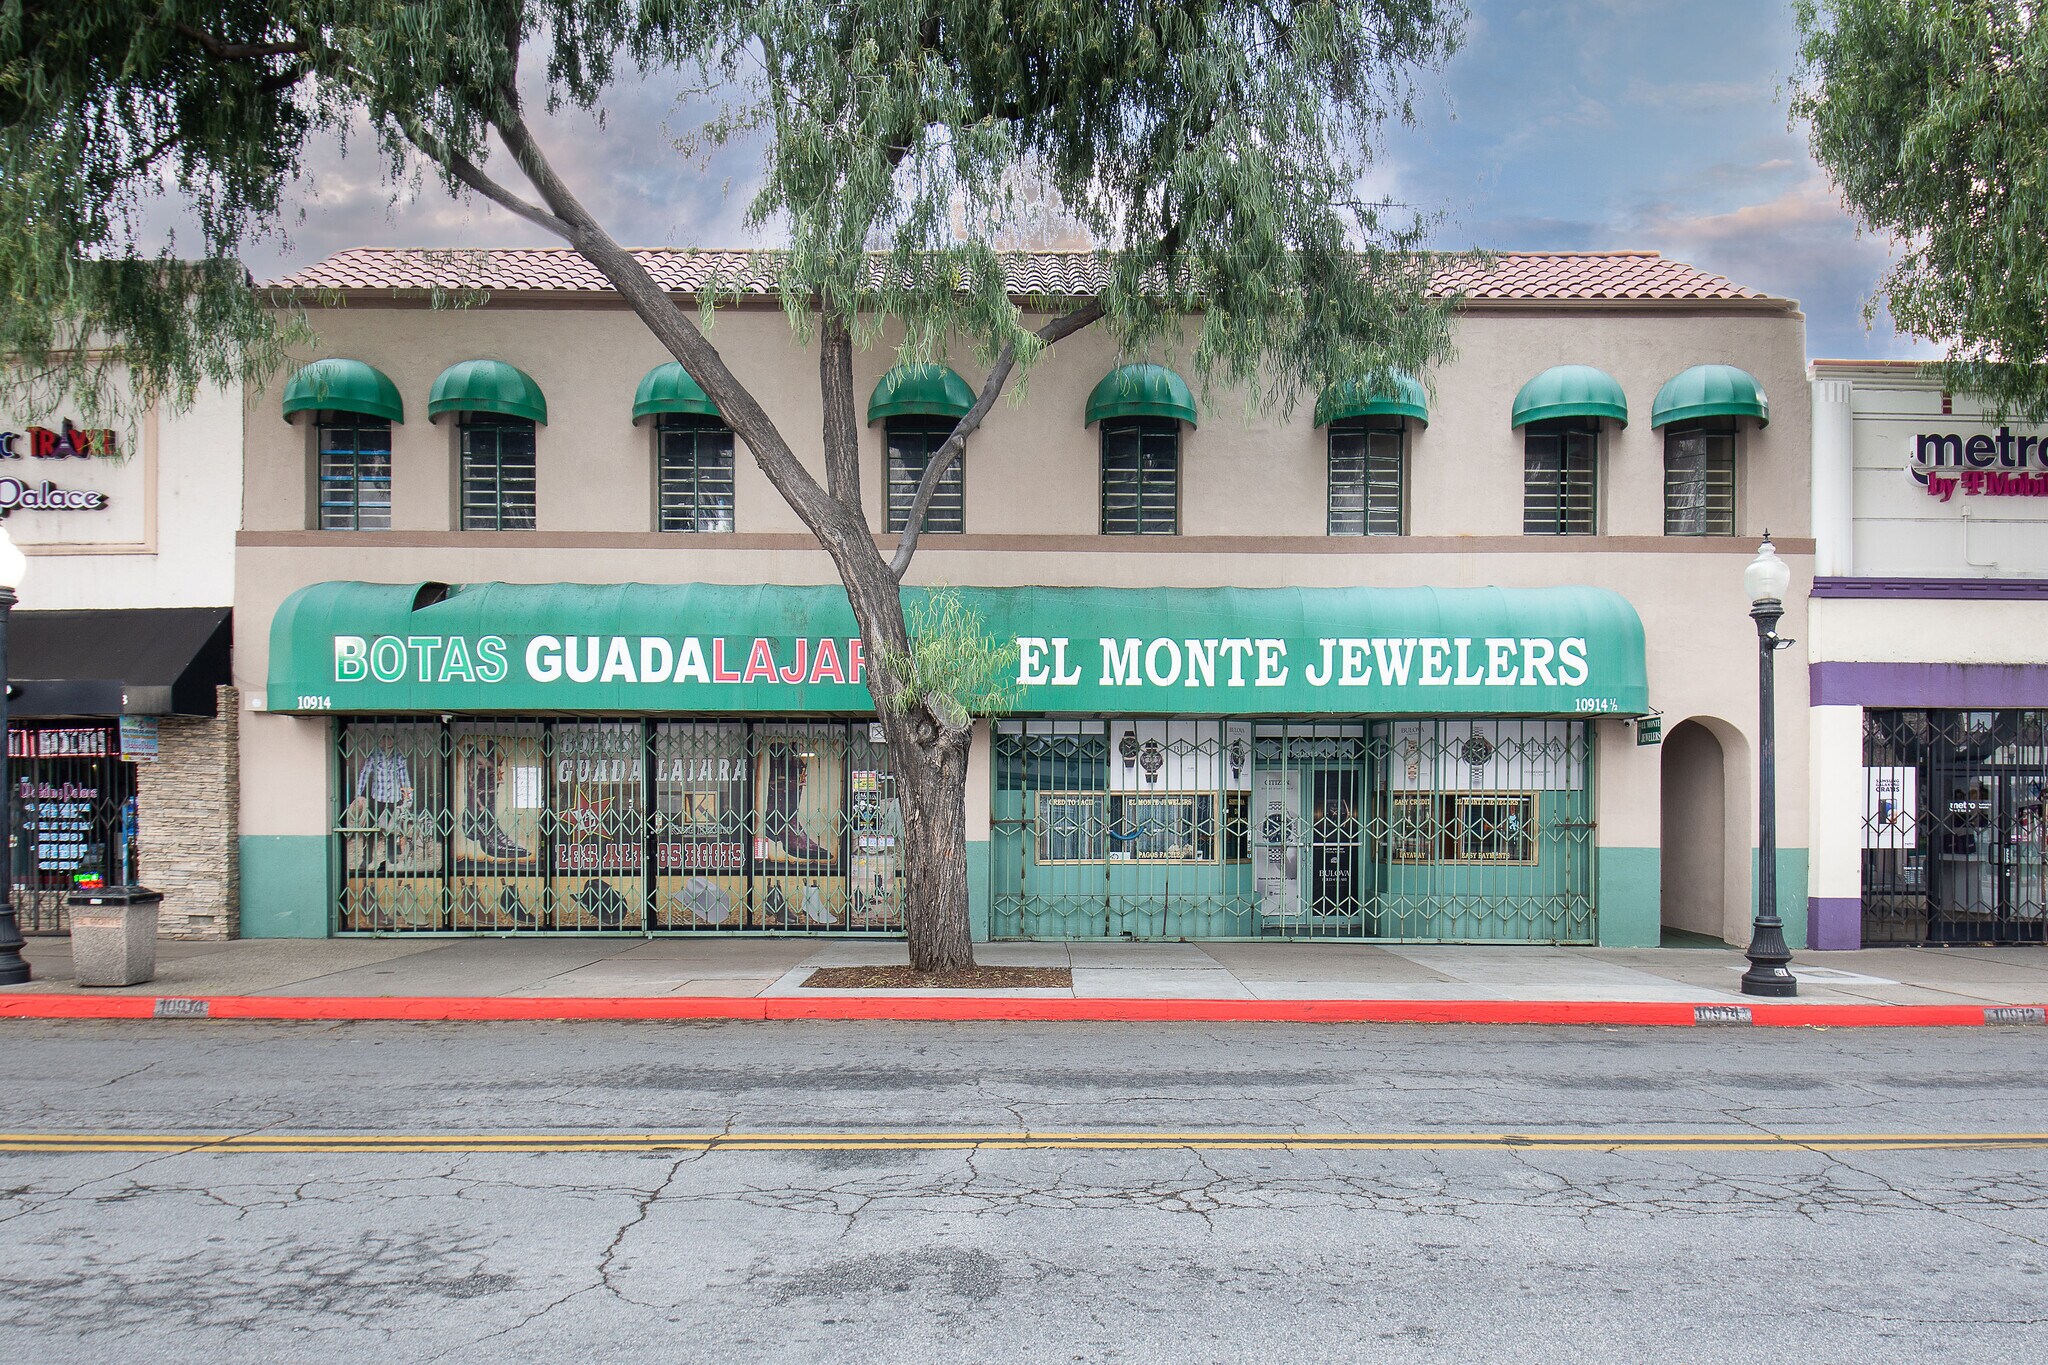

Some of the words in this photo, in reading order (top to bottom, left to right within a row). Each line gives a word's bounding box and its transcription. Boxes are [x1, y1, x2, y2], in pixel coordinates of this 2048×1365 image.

[1928, 471, 1959, 503] by
[334, 634, 508, 683] BOTAS
[525, 634, 867, 685] GUADALAJAR
[1016, 637, 1082, 686] EL
[1099, 637, 1289, 687] MONTE
[1305, 637, 1589, 687] JEWELERS
[297, 695, 332, 710] 10914
[1575, 698, 1608, 712] 10914
